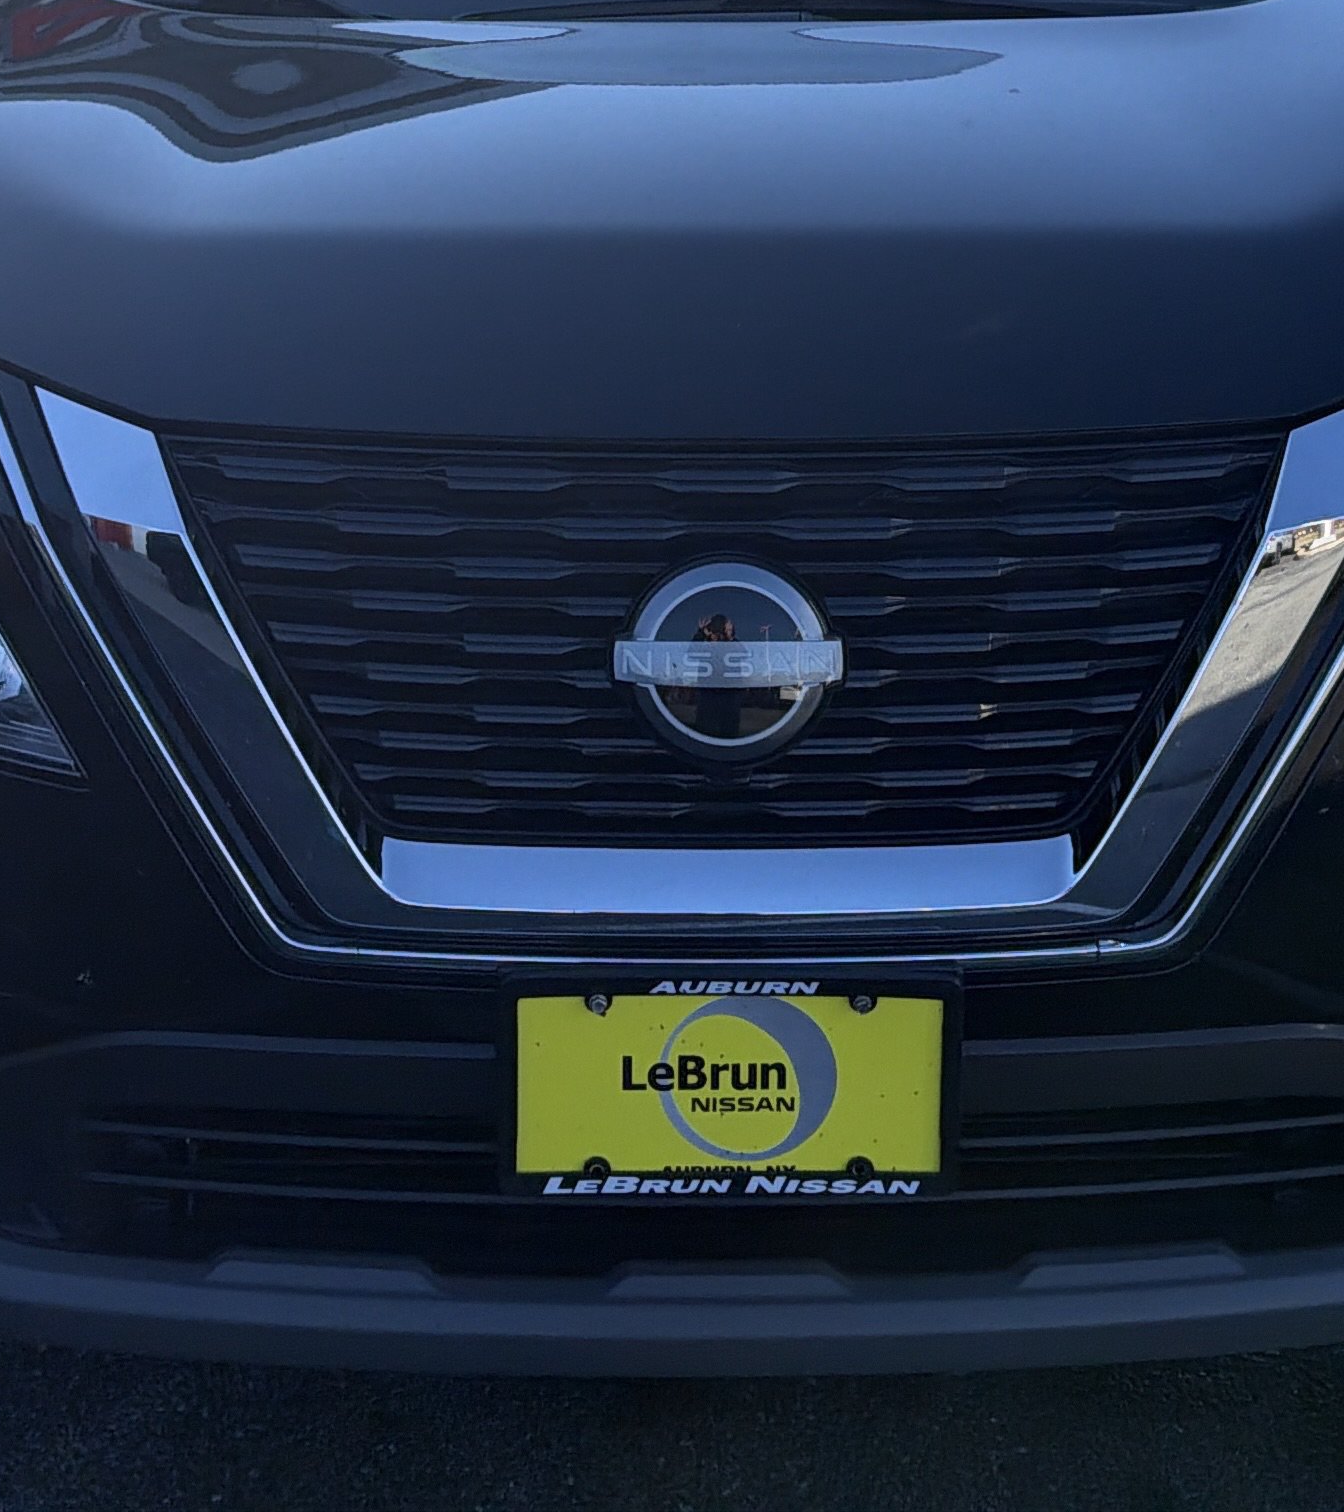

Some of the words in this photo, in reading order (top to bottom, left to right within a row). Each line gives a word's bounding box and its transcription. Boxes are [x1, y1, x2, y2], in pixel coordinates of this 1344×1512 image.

[621, 648, 836, 678] NISSAN
[649, 980, 820, 995] AUBURN
[622, 1055, 787, 1091] LeBrun
[690, 1097, 795, 1113] NISSAN
